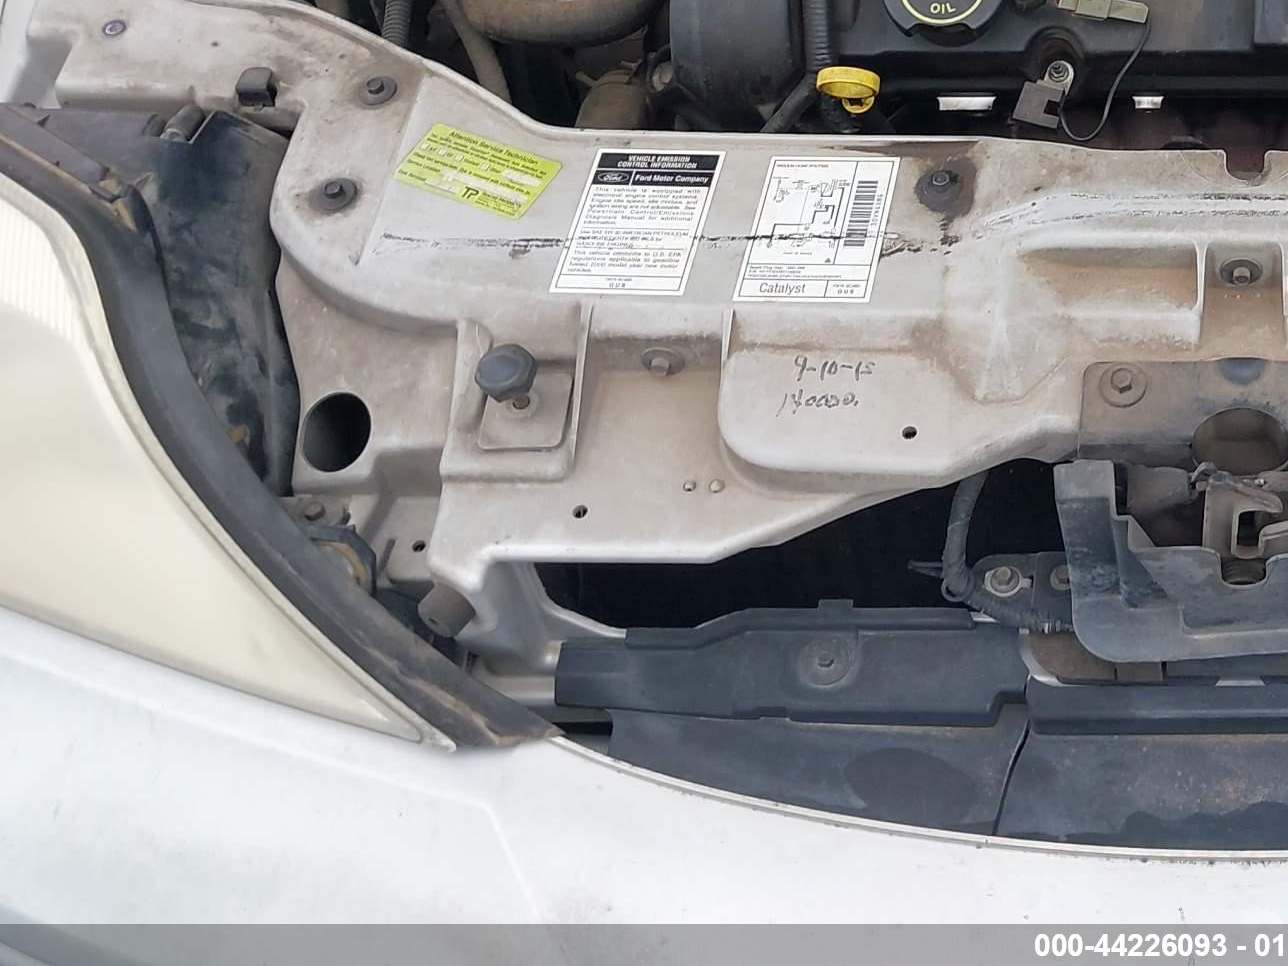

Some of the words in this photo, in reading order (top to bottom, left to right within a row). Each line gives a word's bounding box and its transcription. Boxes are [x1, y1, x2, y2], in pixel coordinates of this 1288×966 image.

[930, 2, 957, 14] OIL
[450, 131, 479, 145] Attention
[480, 140, 504, 154] Service
[504, 148, 539, 165] Technician
[675, 176, 709, 184] Company
[759, 282, 806, 294] Catalyst
